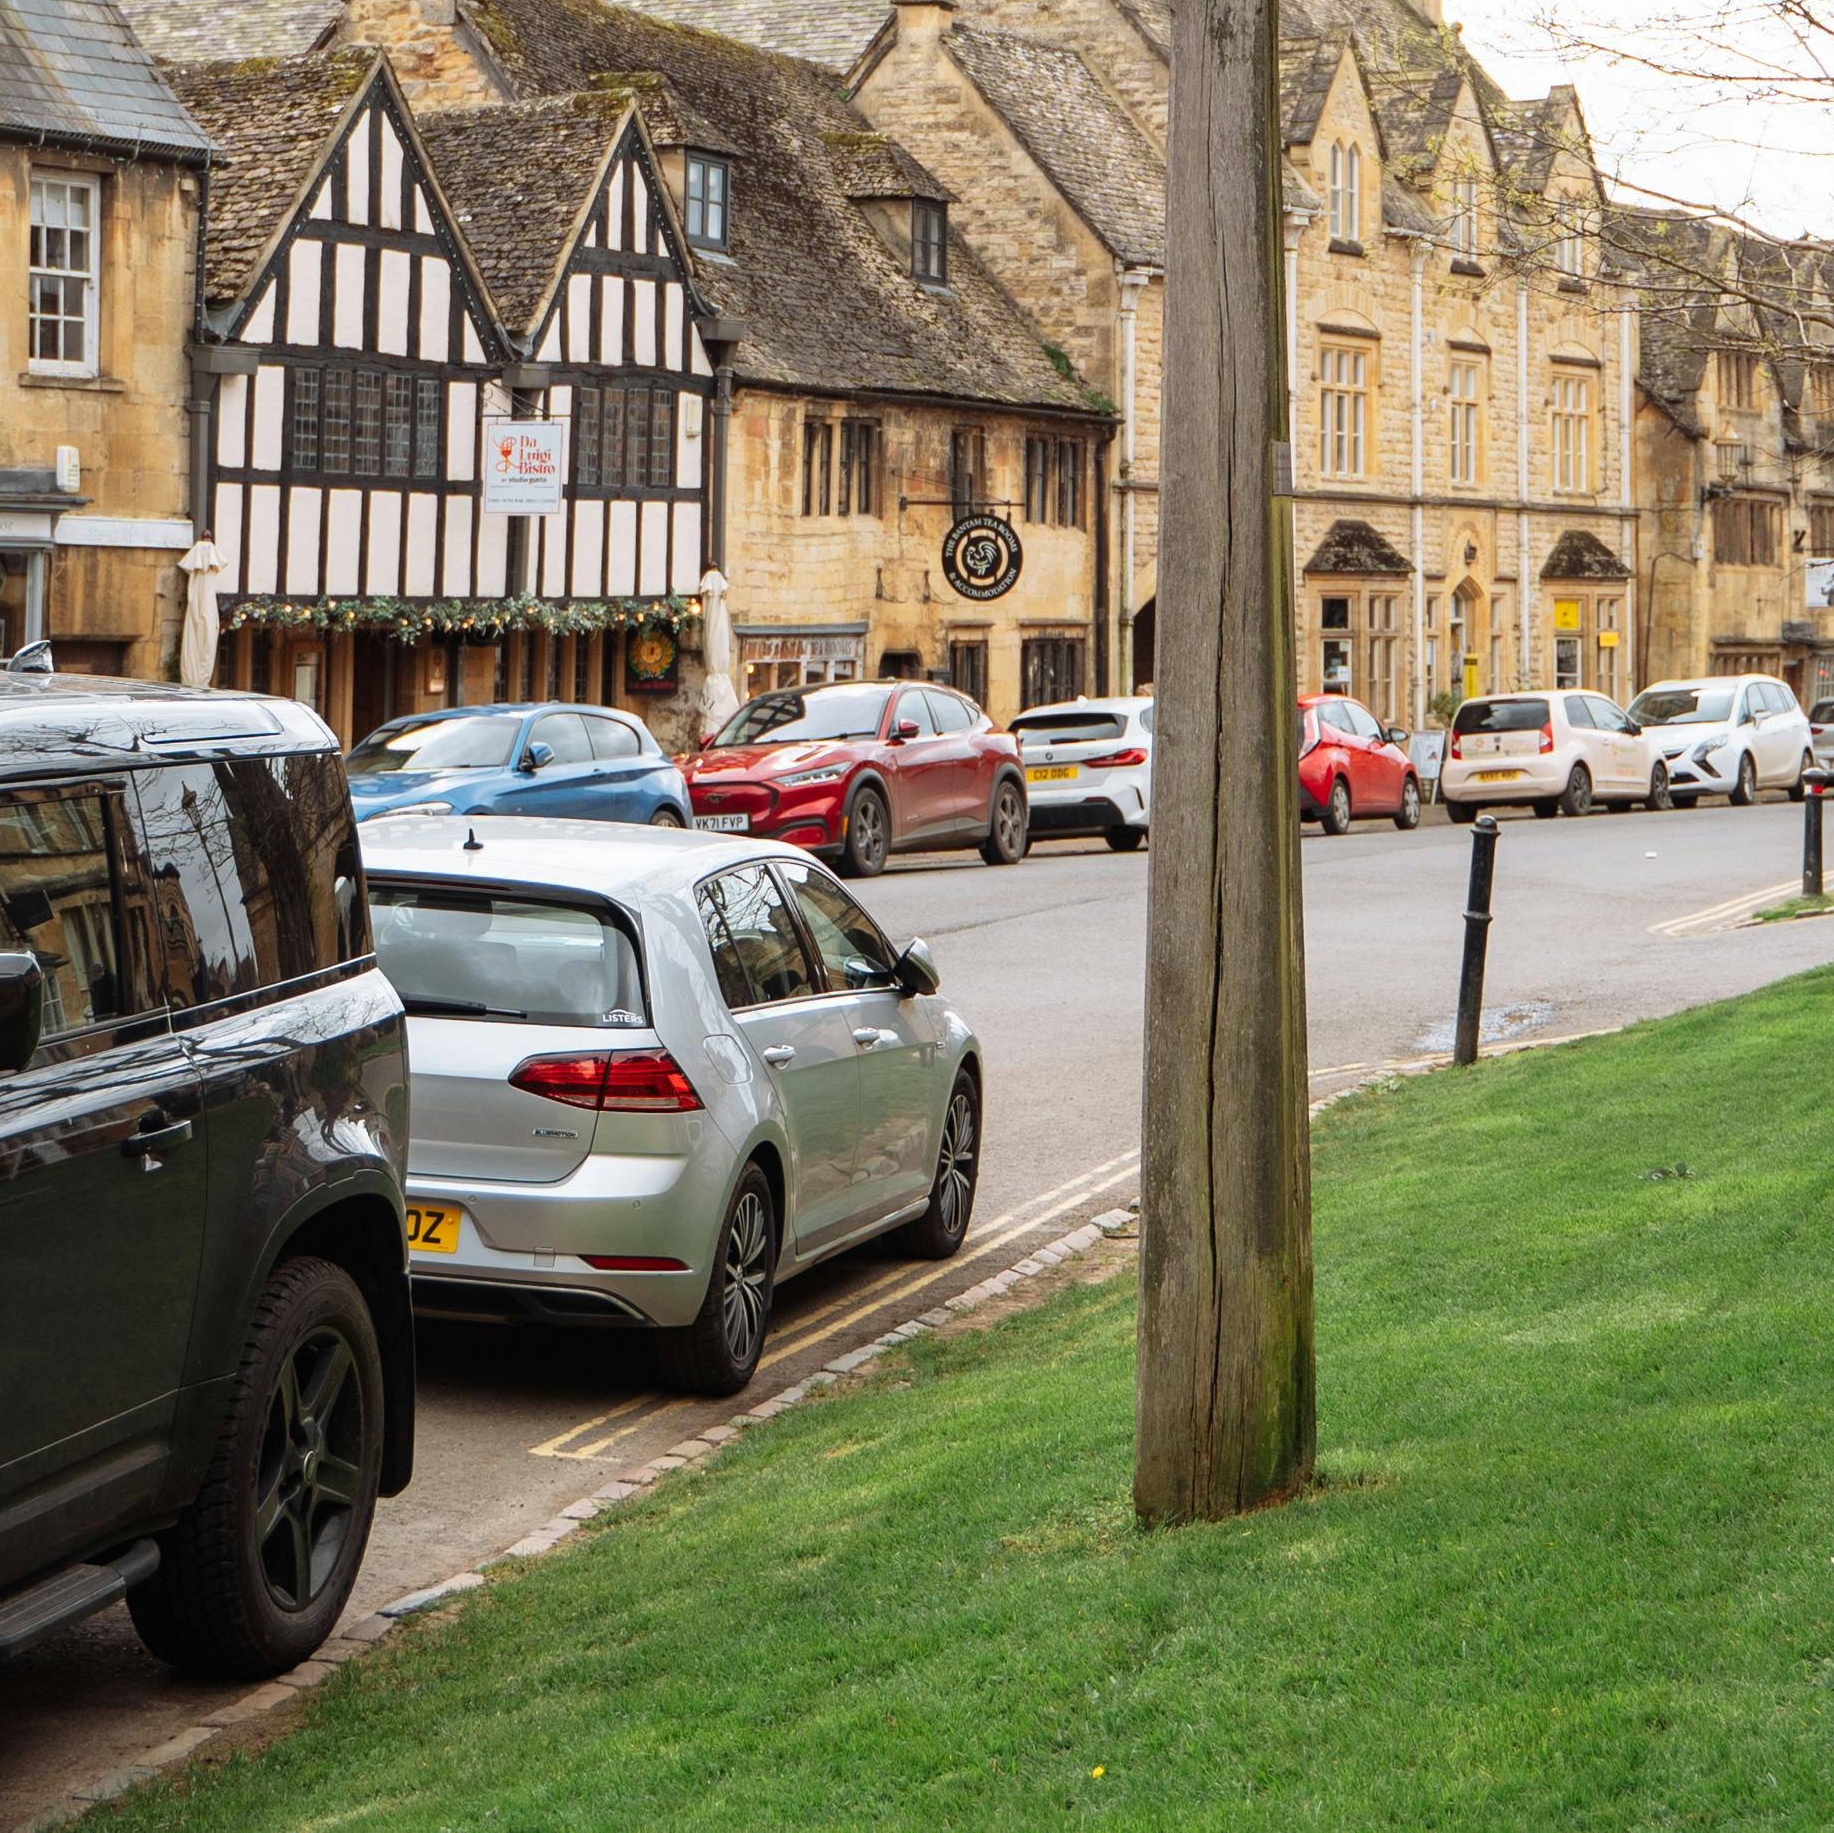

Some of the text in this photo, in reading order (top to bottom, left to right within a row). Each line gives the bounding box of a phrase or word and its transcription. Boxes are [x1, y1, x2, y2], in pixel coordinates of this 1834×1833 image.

[521, 436, 536, 447] Da
[520, 449, 551, 463] Luigi
[519, 462, 555, 474] Bistro
[946, 518, 1018, 557] THE BANTAM TEA ROOMS
[954, 568, 1017, 597] ACCOMMODATION
[695, 816, 743, 829] VK71 FVP
[602, 1013, 644, 1024] LISTERS
